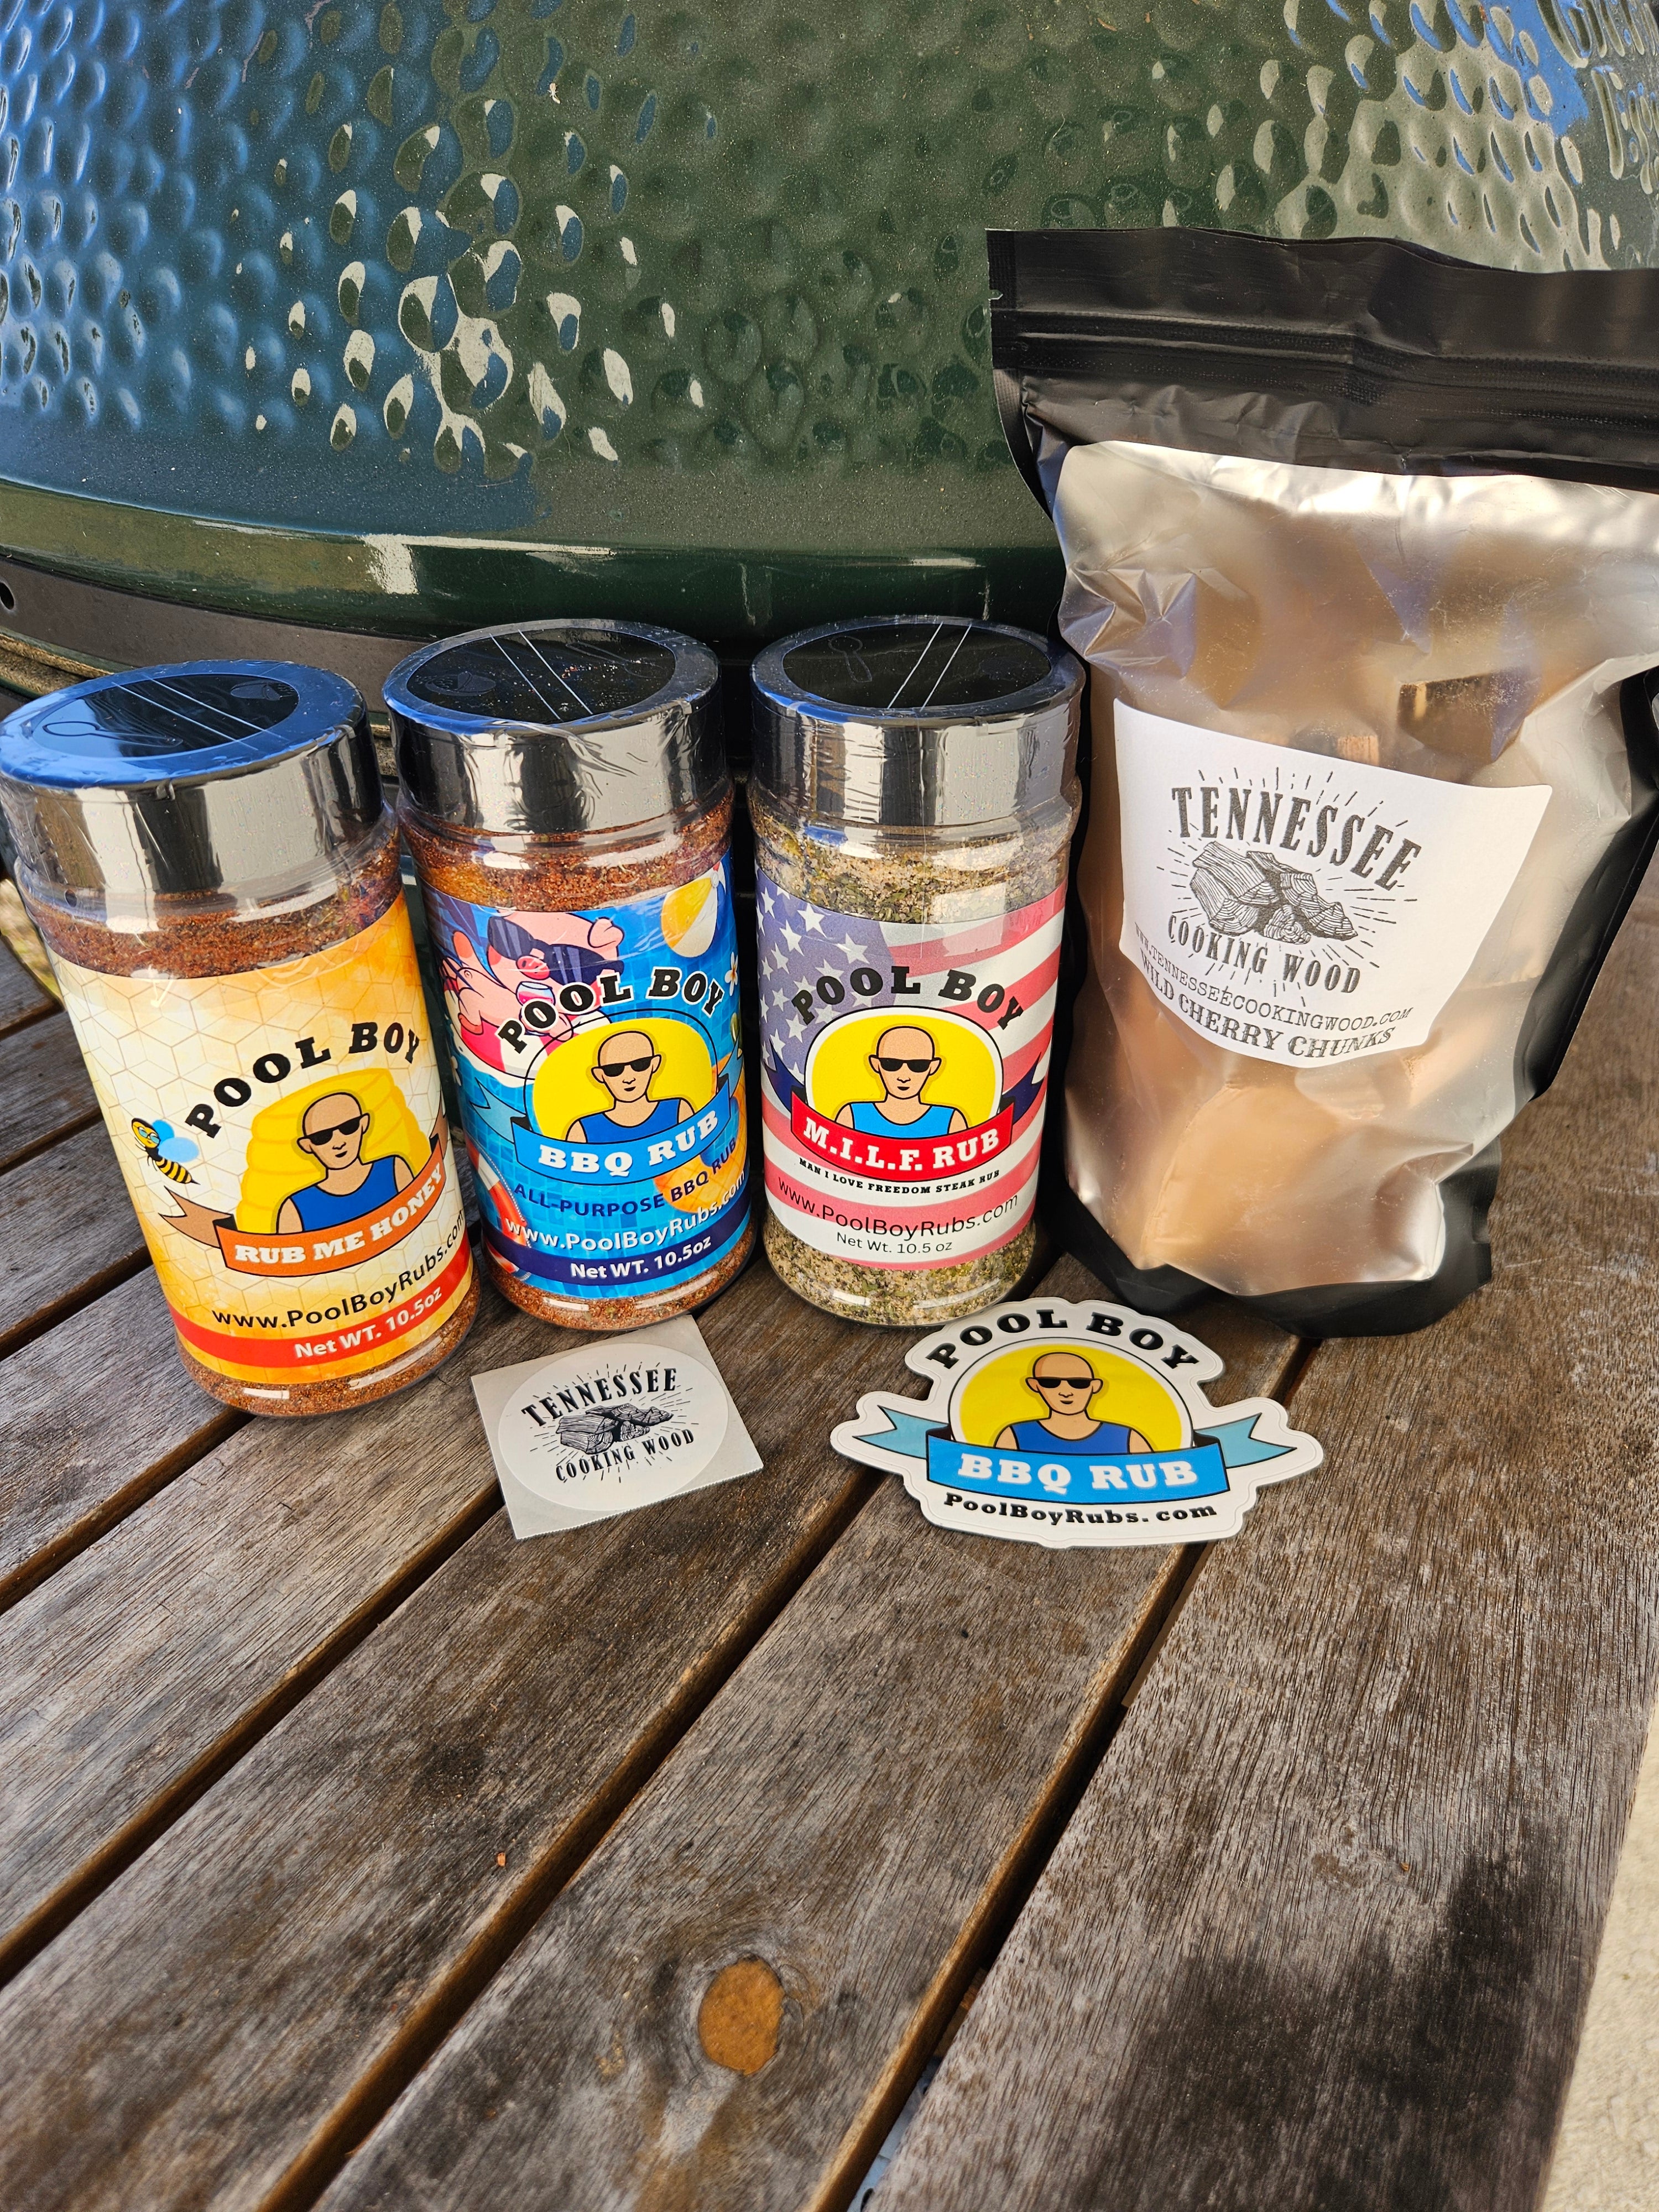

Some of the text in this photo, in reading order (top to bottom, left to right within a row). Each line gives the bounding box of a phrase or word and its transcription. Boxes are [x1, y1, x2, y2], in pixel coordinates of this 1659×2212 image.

[1172, 786, 1422, 891] TENNESSEE
[1134, 922, 1413, 1031] WWW.TENNESSEECOOKINGWOOD.COM
[1168, 915, 1361, 993] COOKING WOOD
[498, 968, 724, 1054] POOL BOY
[791, 966, 1024, 1031] POOL BOY
[1140, 947, 1396, 1058] WILD CHERRY CHUNKS
[185, 1021, 419, 1139] POOL BOY
[514, 1137, 736, 1217] ALL-PURPOSE BBQ RUB
[538, 1110, 719, 1177] BBQ RUB
[799, 1157, 821, 1175] MAN
[833, 1173, 863, 1189] LOVE
[868, 1183, 931, 1194] FREEDOM
[935, 1178, 975, 1193] STEAK
[979, 1169, 1000, 1183] RUB
[803, 1116, 999, 1172] M.I.L.F. RUB
[235, 1162, 441, 1265] RUB ME HONEY
[505, 1170, 745, 1251] www.PoolBoyRubs.com
[778, 1176, 1018, 1241] www.PoolBoyRubs.com
[837, 1232, 952, 1254] Net Wt. 10.5 oz
[212, 1210, 463, 1328] www.PoolBoyRubs.com
[571, 1235, 711, 1279] Net WT. 10.5oz
[295, 1287, 442, 1358] Net WT. 10.5oz
[925, 1308, 1199, 1370] POOL BOY
[521, 1368, 676, 1426] TENNESSEE
[556, 1428, 695, 1481] COOKING WOOD
[957, 1453, 1197, 1494] BBQ RUB
